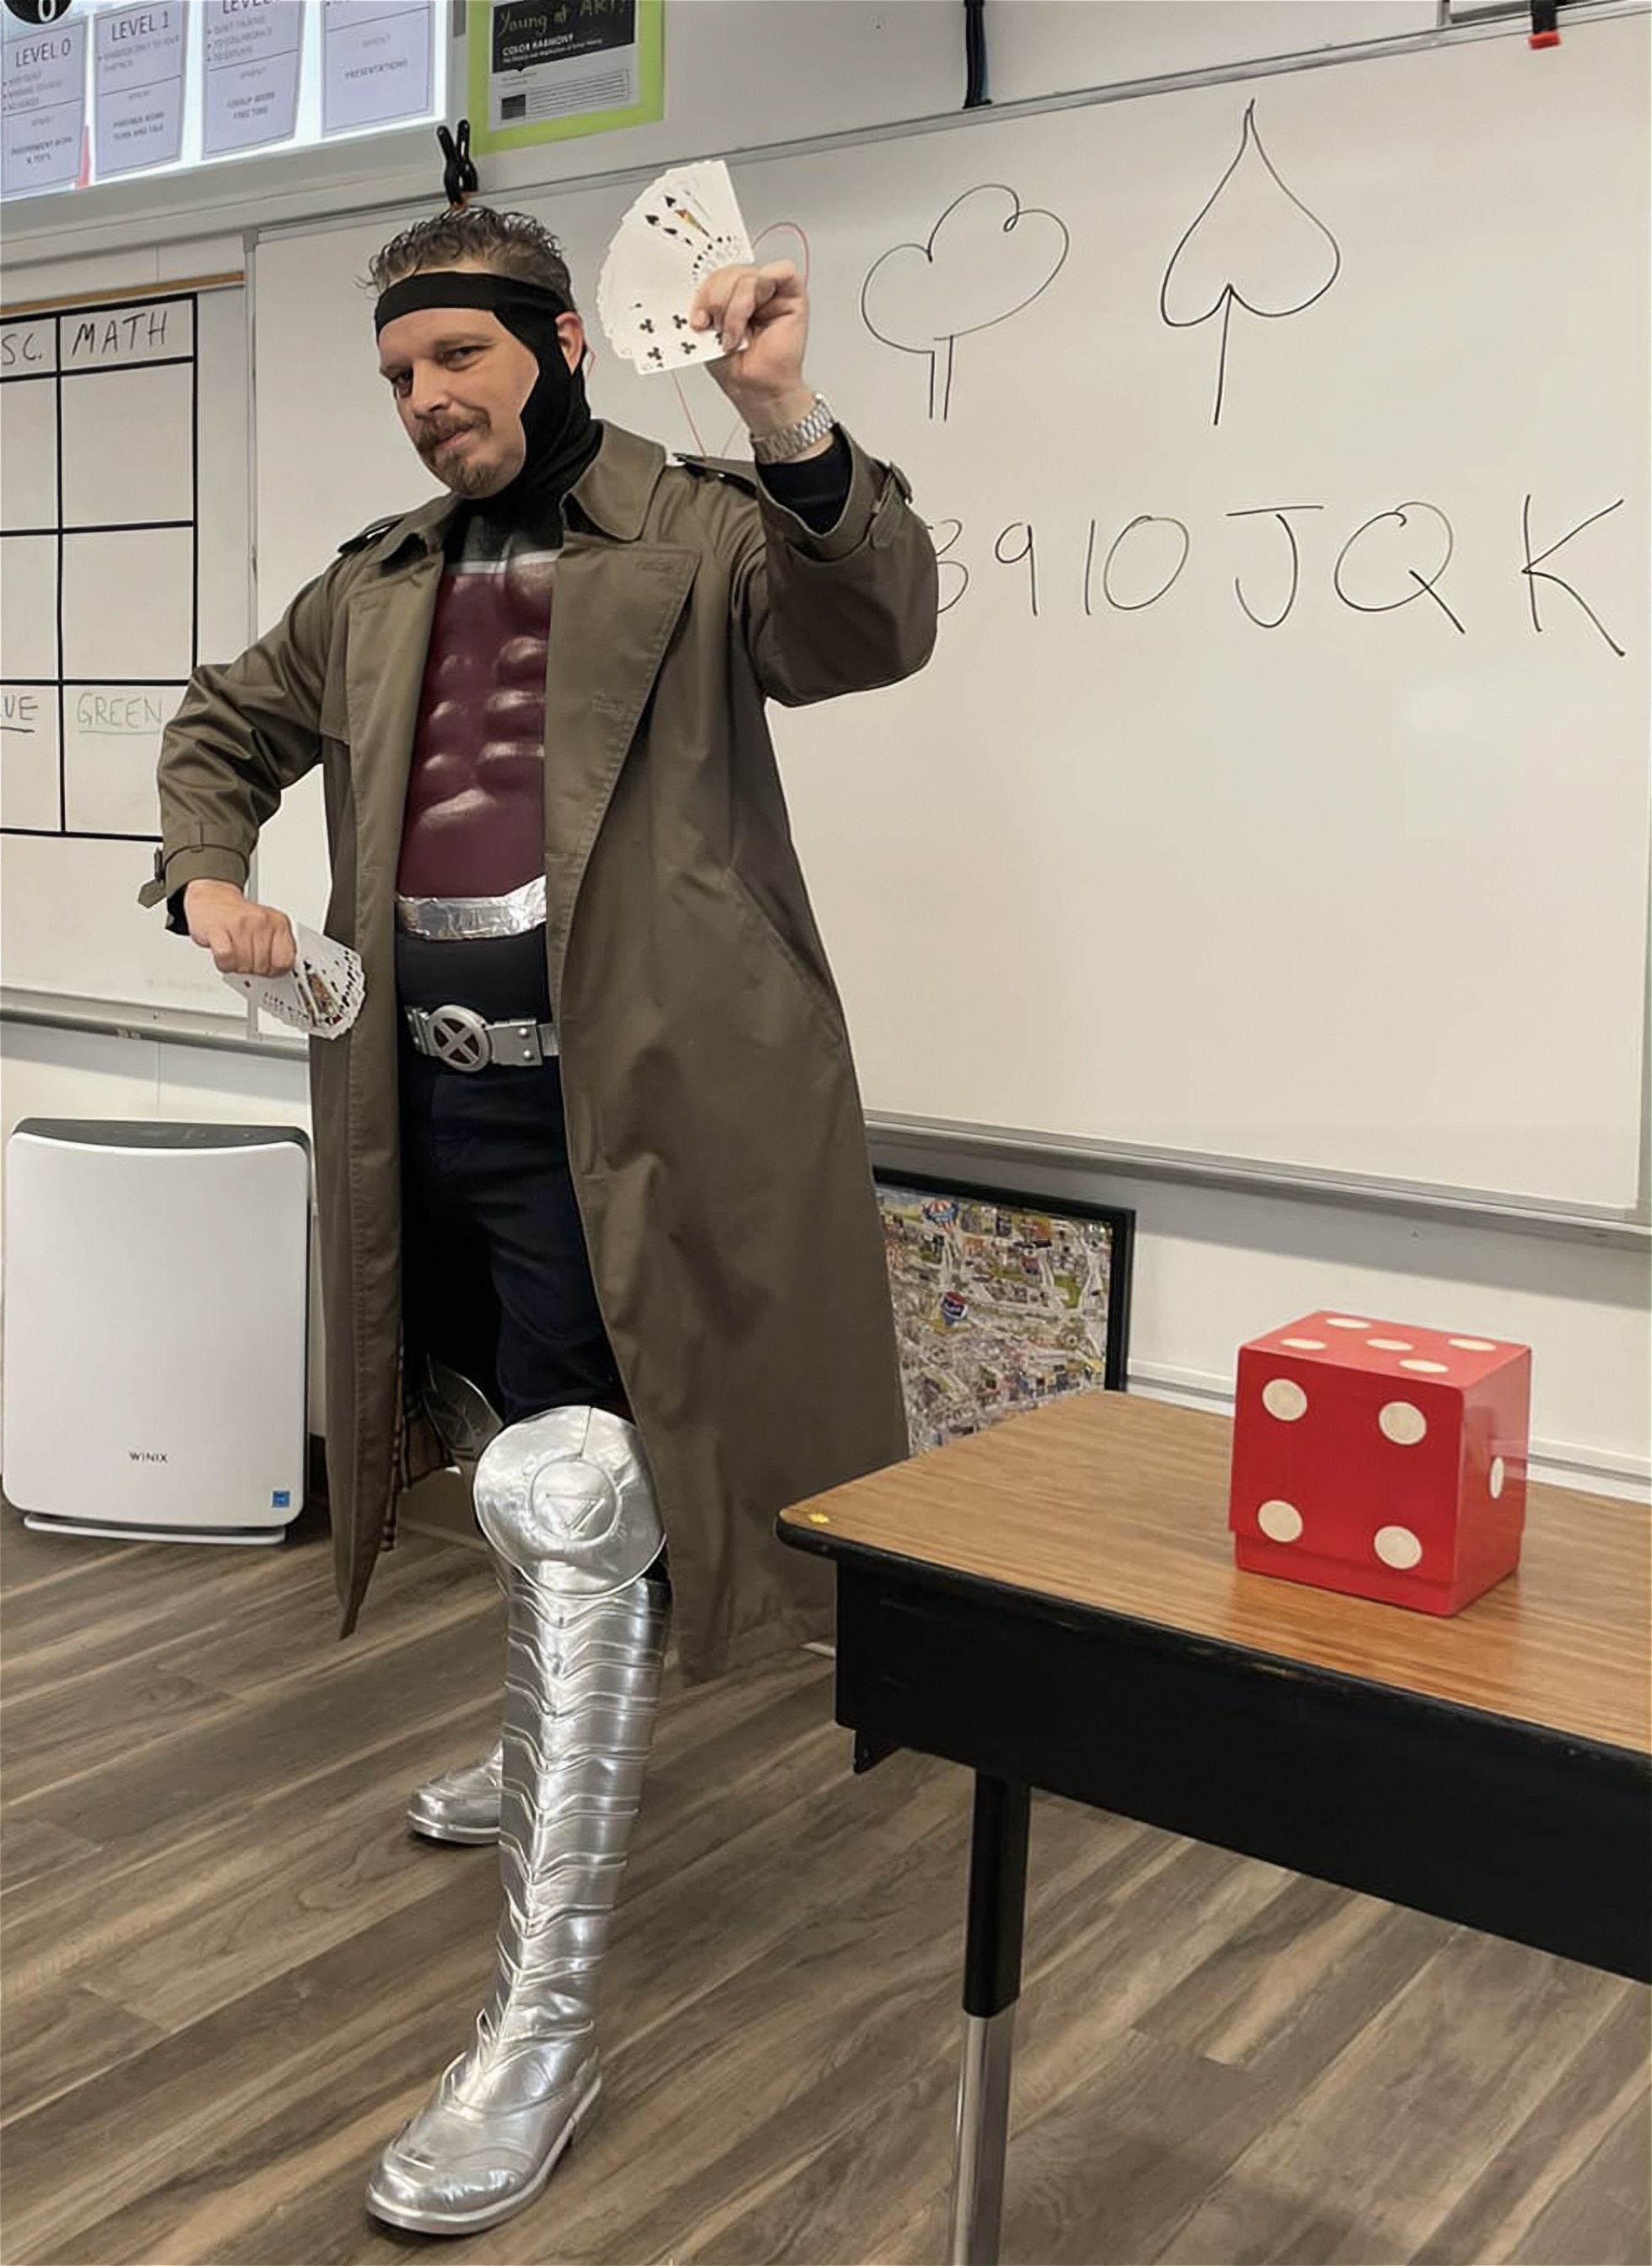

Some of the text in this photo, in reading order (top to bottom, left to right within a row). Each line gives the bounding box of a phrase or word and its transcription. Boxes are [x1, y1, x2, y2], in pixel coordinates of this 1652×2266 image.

[112, 10, 170, 41] LEVEL 1
[16, 38, 72, 67] LEVEL 0
[72, 310, 168, 356] MATH
[995, 522, 1038, 616] 9
[1084, 515, 1190, 616] 10
[1227, 504, 1324, 629] J
[1333, 501, 1466, 634] Q
[1520, 493, 1627, 657] K
[0, 694, 39, 721] UE
[77, 692, 163, 729] GREEN
[128, 1450, 169, 1464] WINIX
